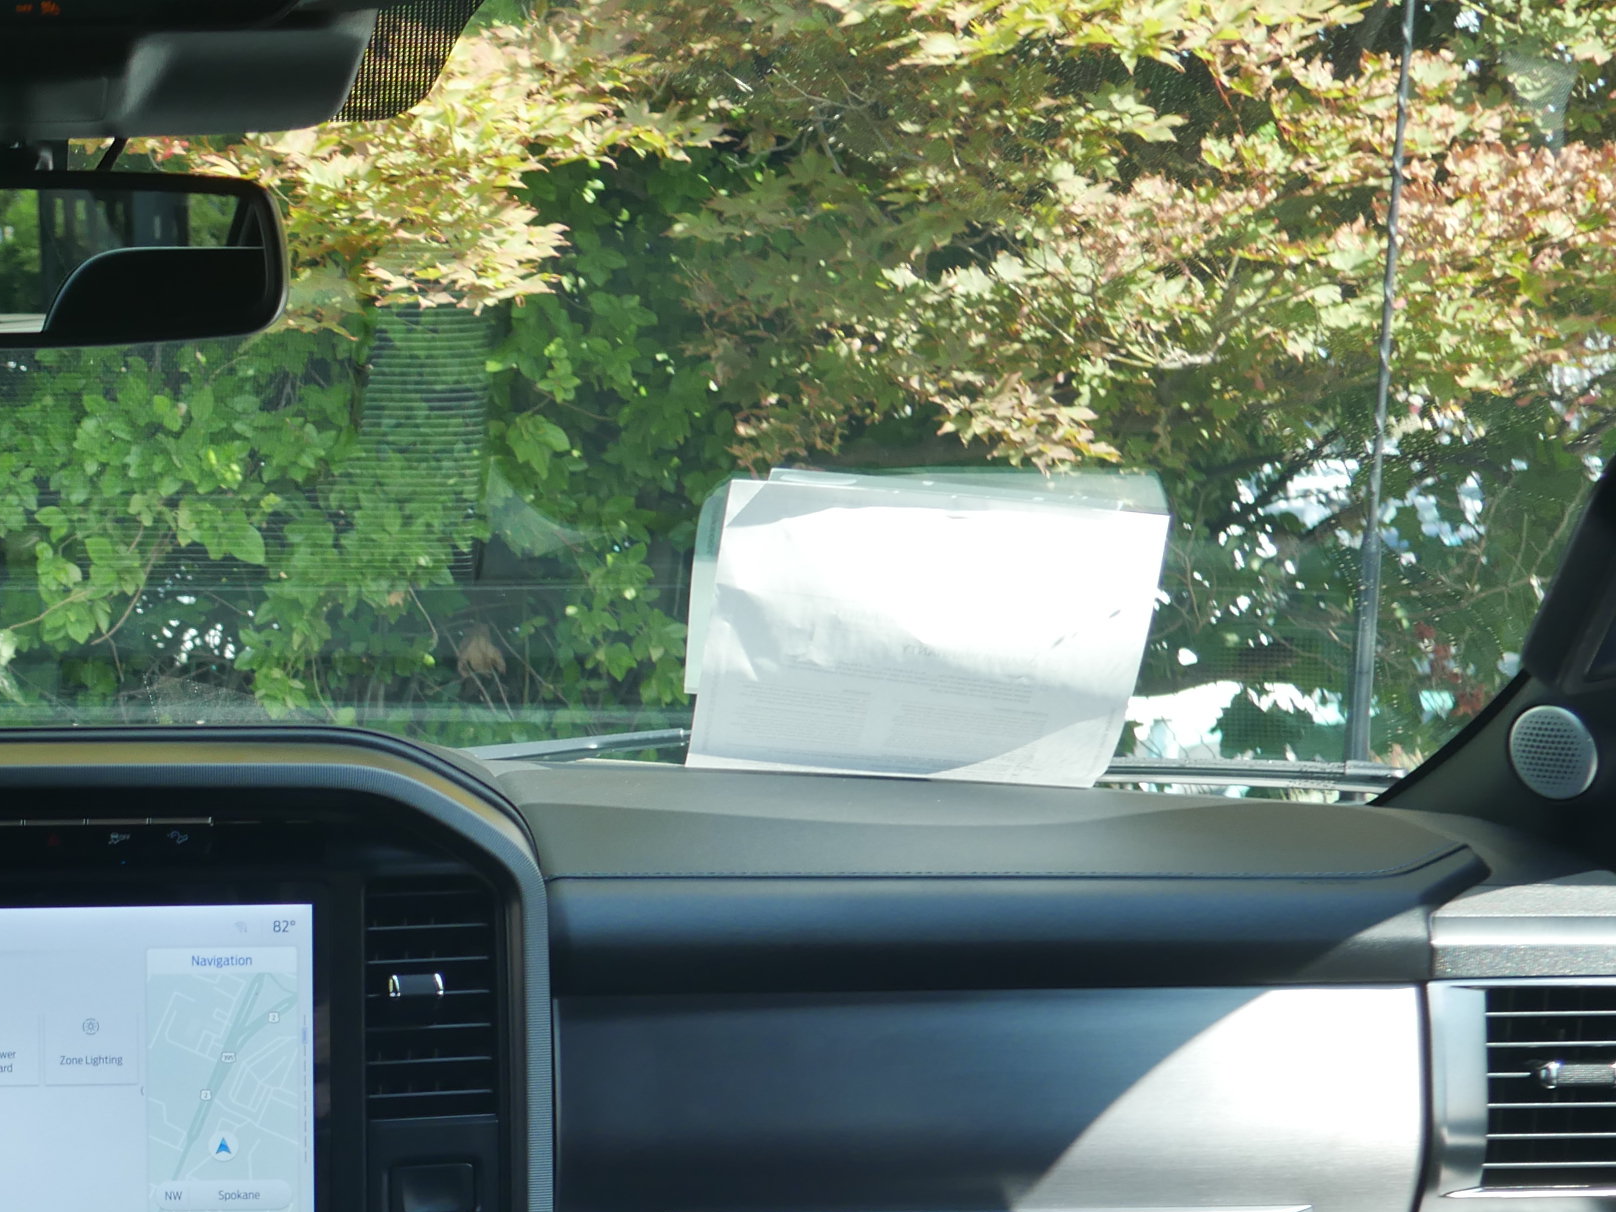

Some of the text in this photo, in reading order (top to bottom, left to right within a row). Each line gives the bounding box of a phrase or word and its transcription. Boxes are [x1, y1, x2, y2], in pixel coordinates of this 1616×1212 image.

[272, 919, 297, 933] 82°
[190, 954, 253, 969] Navigation
[59, 1054, 124, 1067] Zone Lighting
[164, 1190, 183, 1201] NW
[218, 1189, 261, 1202] Spokane
